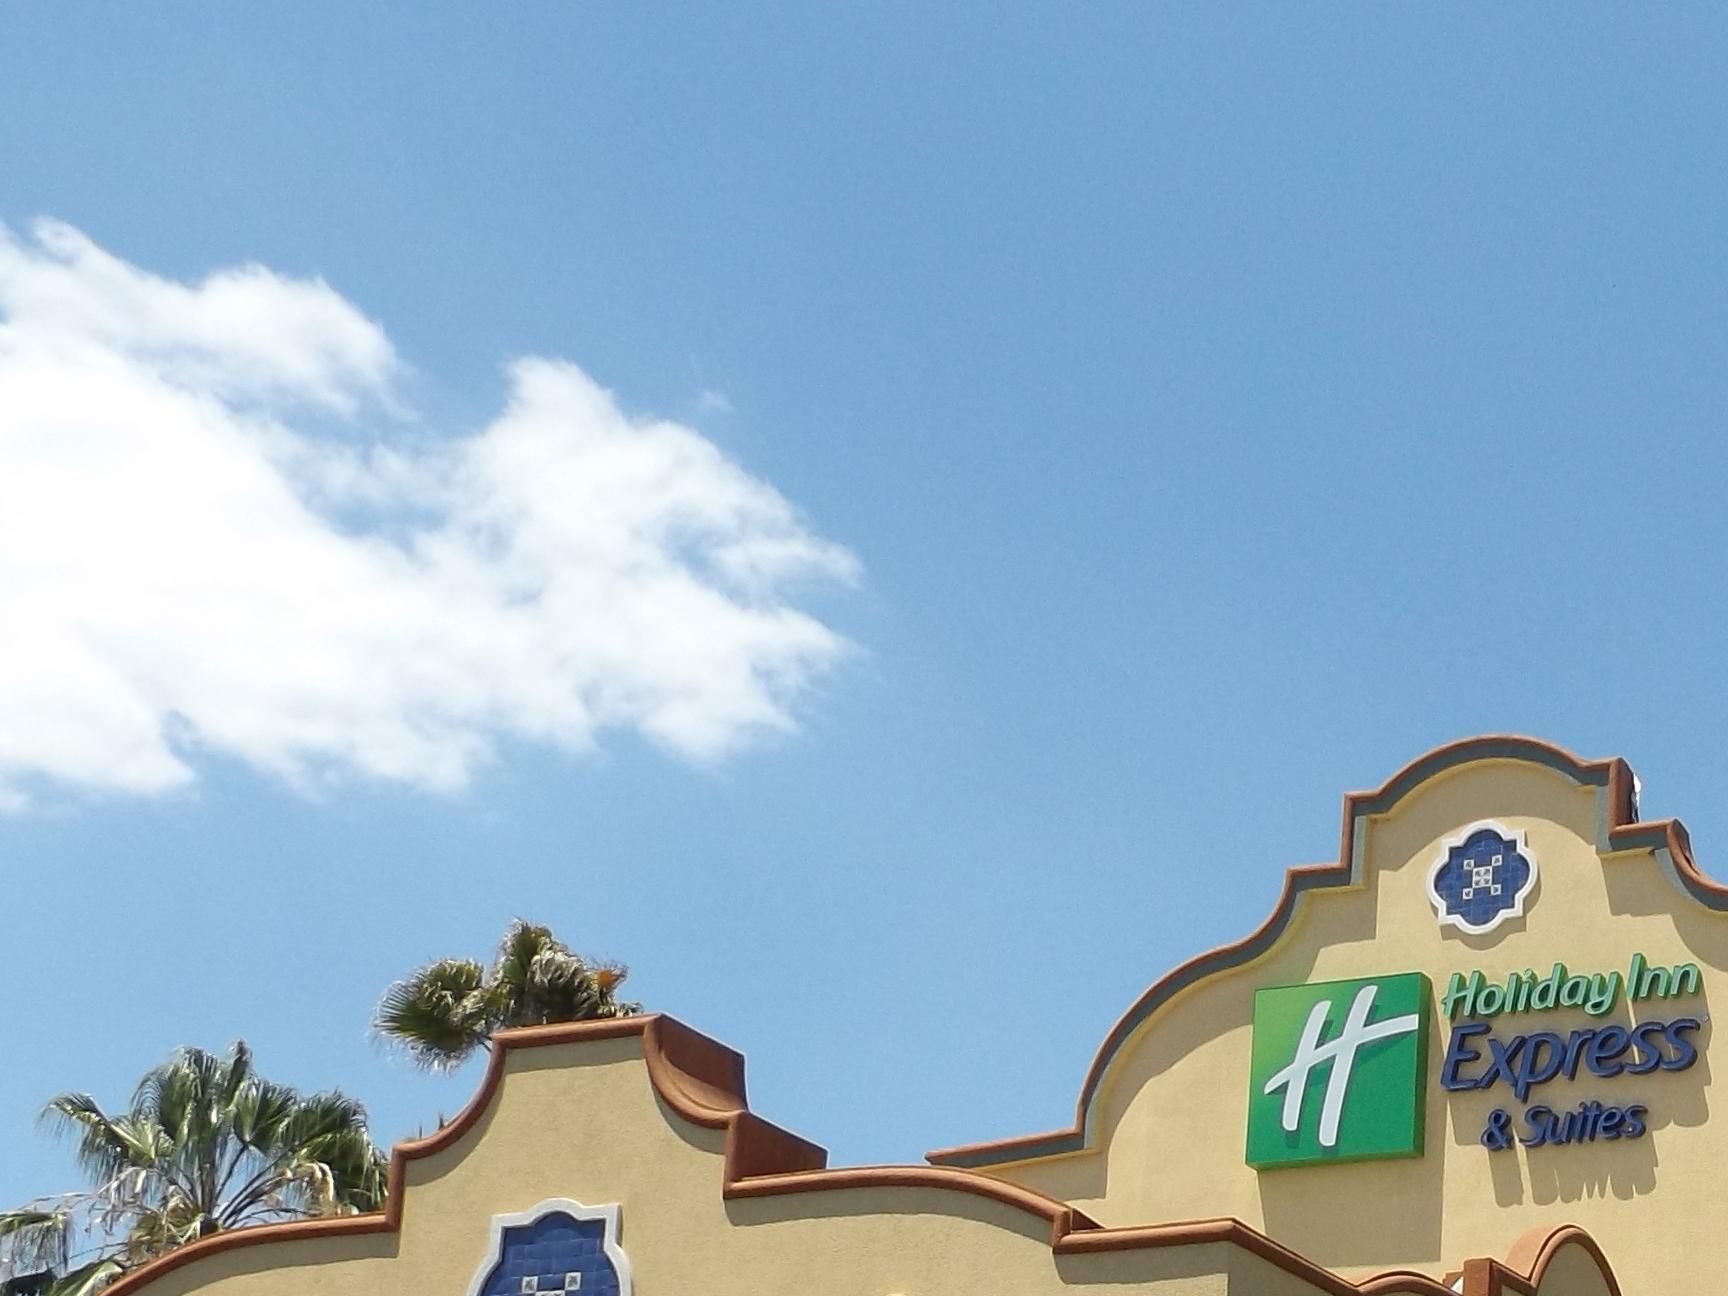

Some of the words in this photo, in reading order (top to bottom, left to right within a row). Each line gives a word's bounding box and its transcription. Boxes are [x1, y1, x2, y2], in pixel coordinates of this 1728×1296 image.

[1441, 962, 1621, 1020] Holiday
[1626, 952, 1700, 1001] Inn
[1263, 984, 1420, 1147] H
[1440, 1018, 1701, 1103] Express
[1480, 1108, 1513, 1151] &
[1518, 1101, 1649, 1147] Suites
